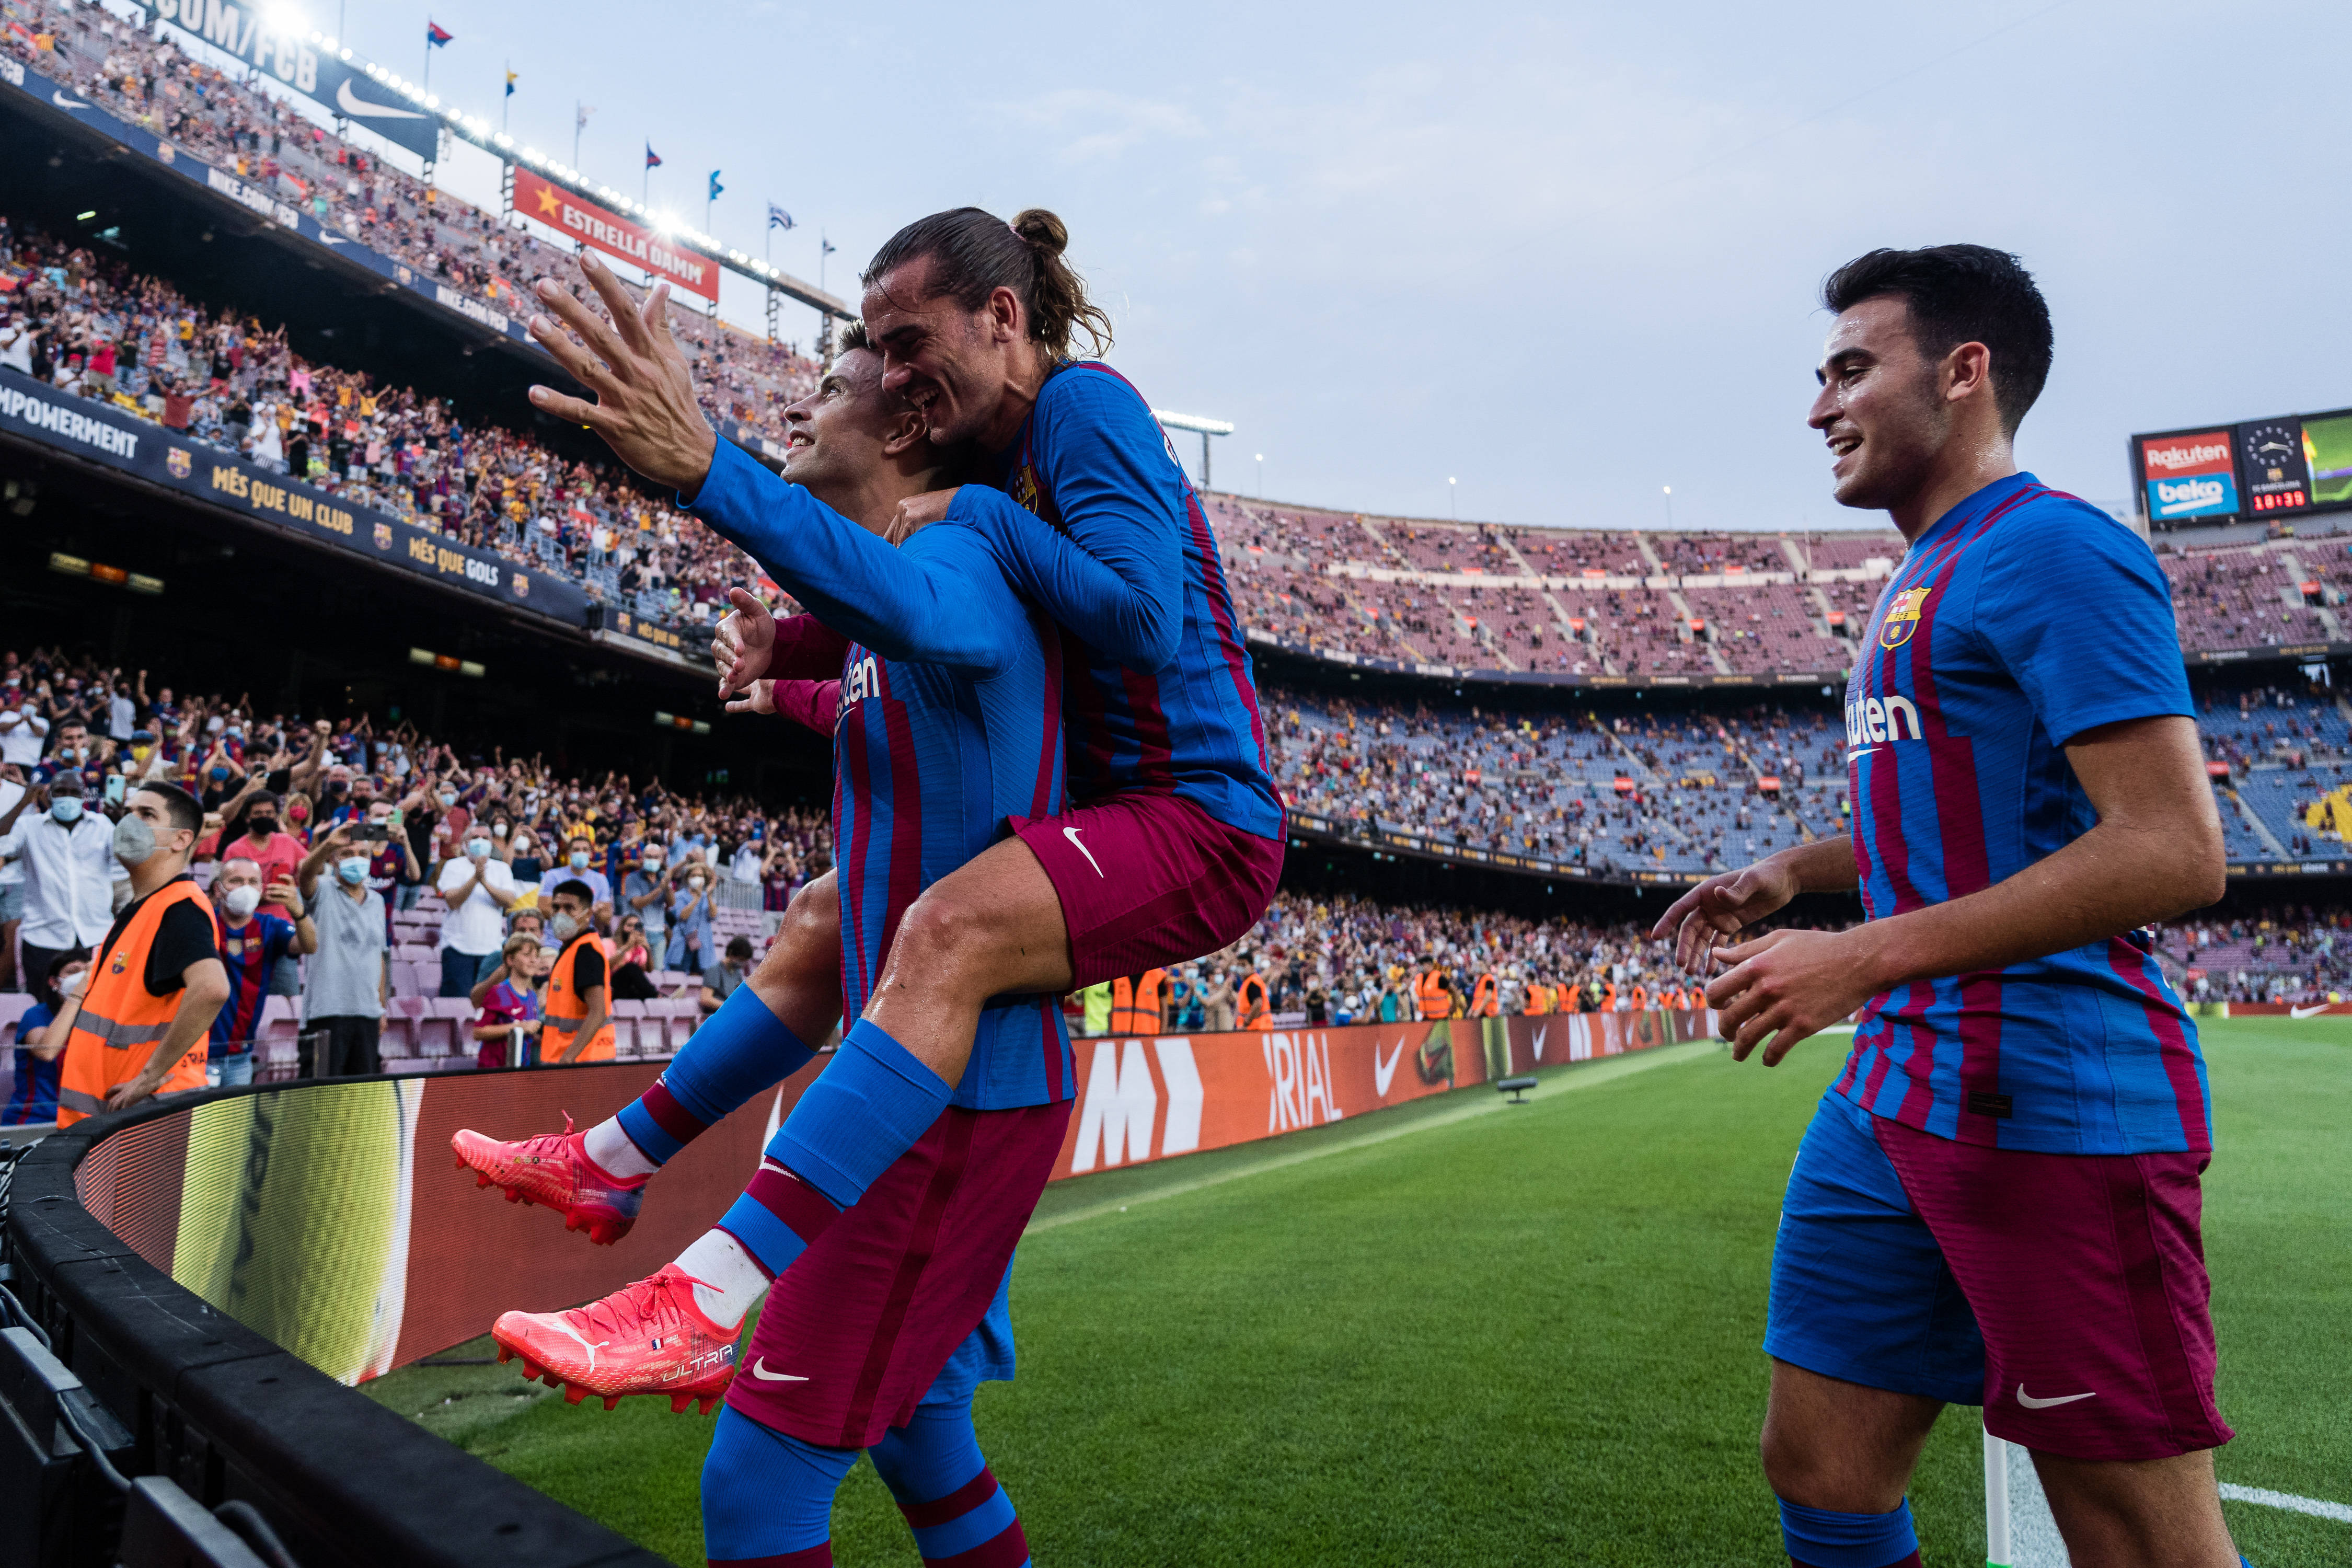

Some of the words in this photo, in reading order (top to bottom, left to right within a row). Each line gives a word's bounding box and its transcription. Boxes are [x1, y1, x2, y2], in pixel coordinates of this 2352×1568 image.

[563, 203, 647, 261] ESTRELLA
[649, 245, 702, 285] DAMM
[2147, 444, 2229, 468] Rakuten
[212, 465, 249, 498] MÉS
[251, 480, 286, 509] QUE
[289, 492, 313, 522] UN
[316, 503, 353, 535] CLUB
[2157, 479, 2224, 503] beko
[409, 537, 436, 564] MÉS
[437, 548, 466, 575] QUE
[466, 558, 499, 586] GOLS
[1894, 612, 1908, 621] FCB
[1262, 1032, 1343, 1133] RIAL
[662, 1344, 733, 1382] ULTRA
